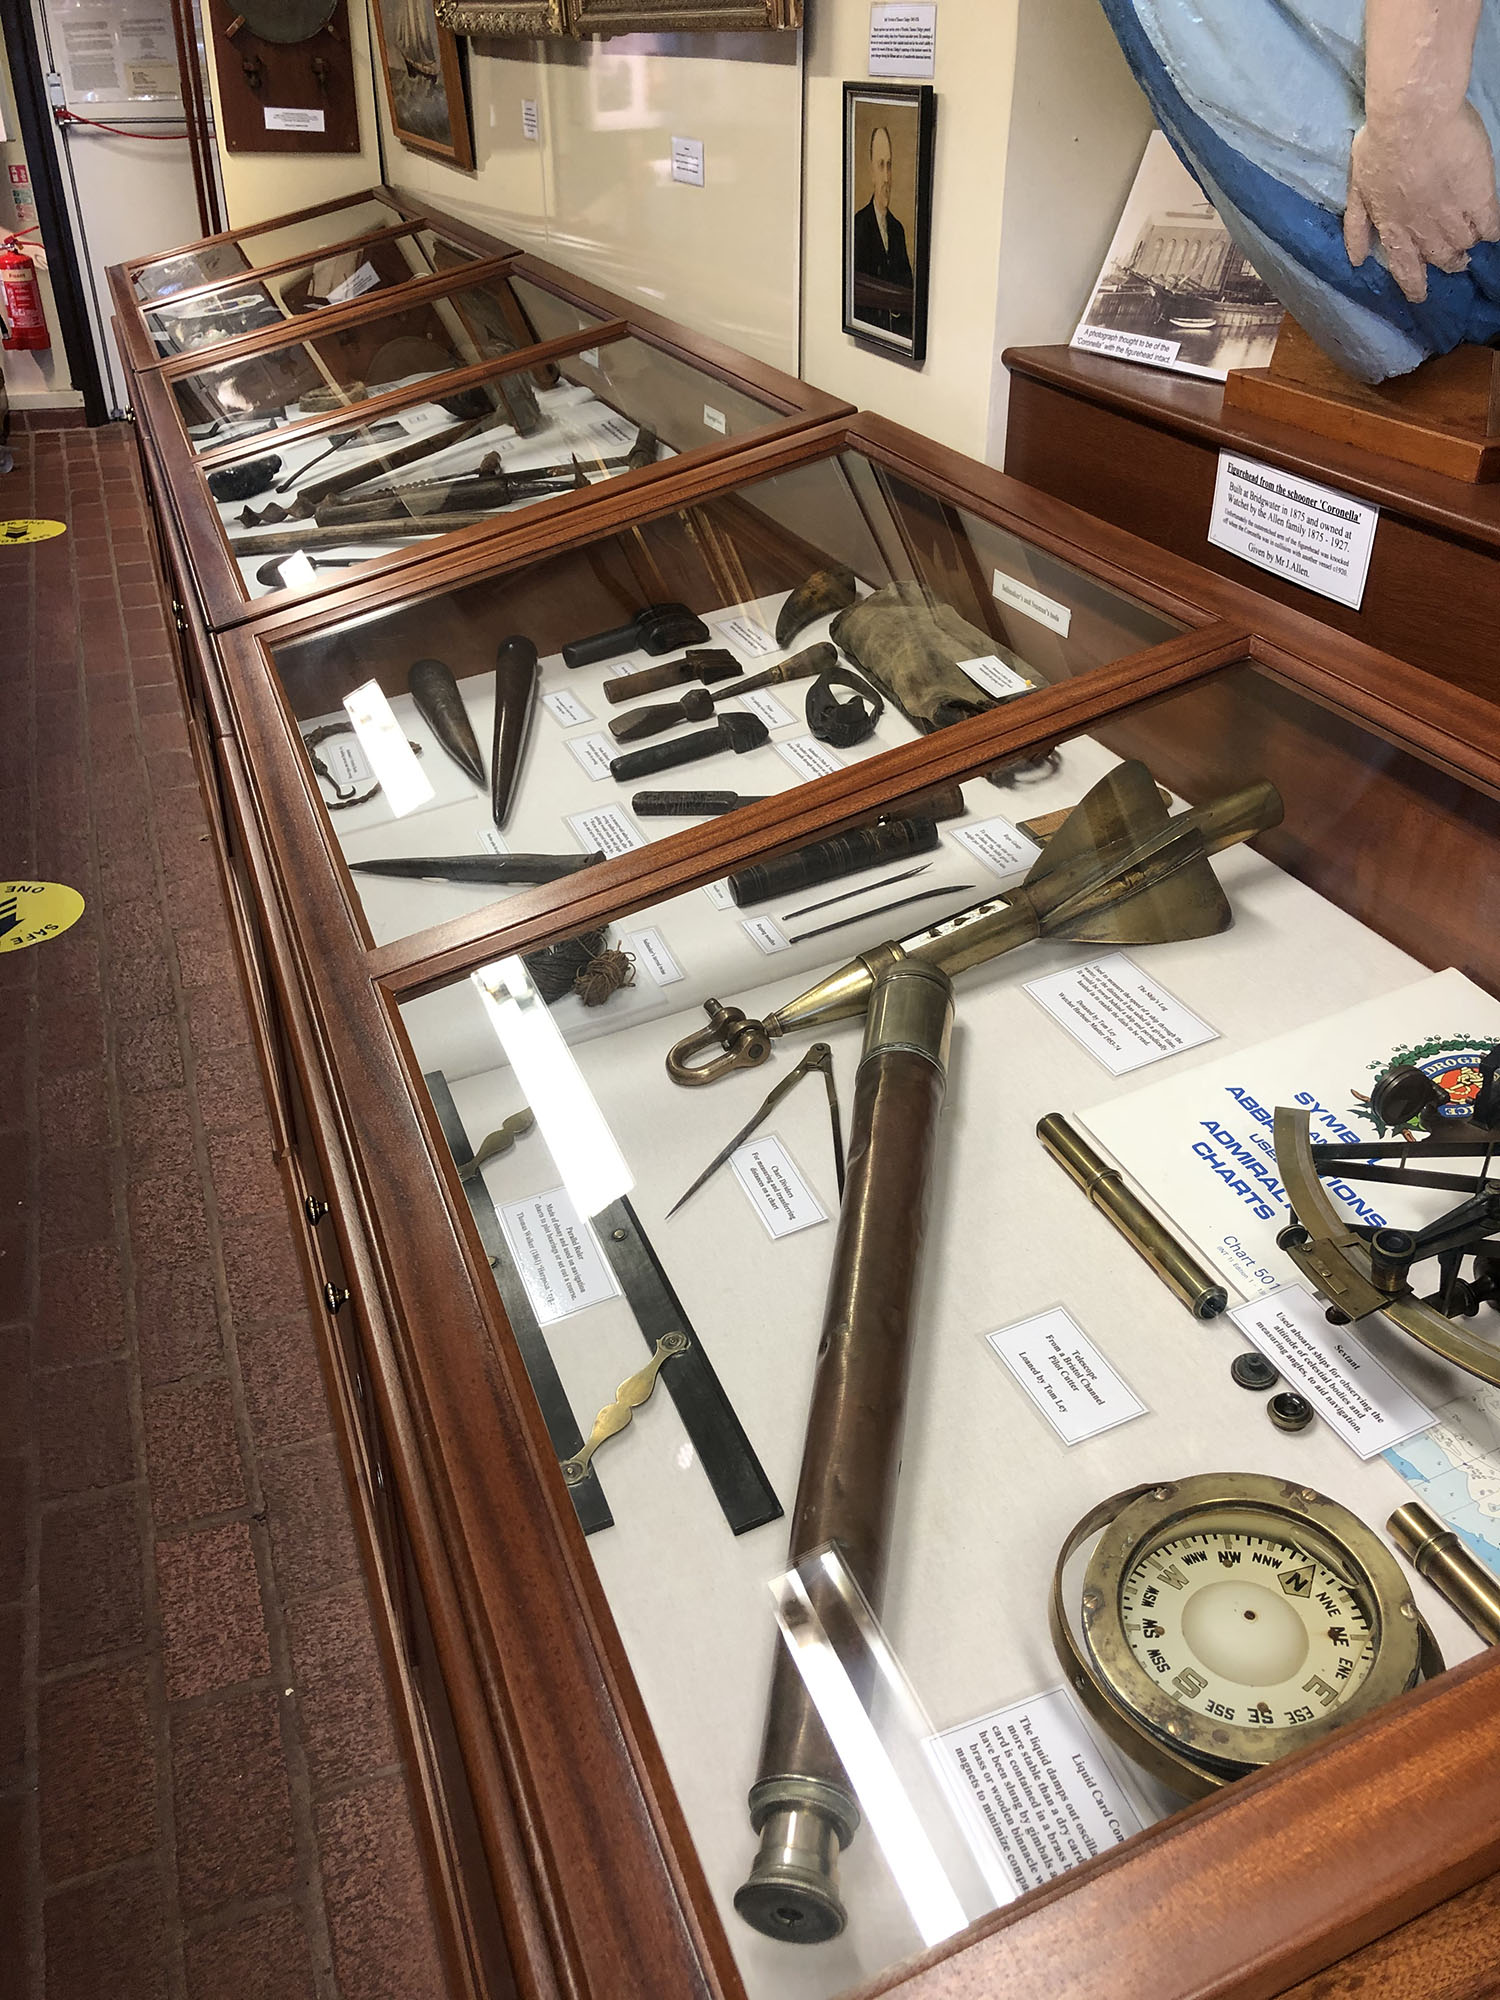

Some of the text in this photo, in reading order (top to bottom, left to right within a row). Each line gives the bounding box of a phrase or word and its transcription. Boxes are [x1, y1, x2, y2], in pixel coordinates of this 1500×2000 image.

[1227, 462, 1361, 524] Figurehead from the schooner 'Coronella'
[1228, 493, 1249, 511] Watchet
[1249, 503, 1257, 516] by
[1257, 507, 1266, 519] the
[1267, 511, 1284, 526] Allen
[1285, 519, 1306, 537] family
[1307, 528, 1324, 542] 1875
[1330, 536, 1349, 553] 1927.
[1229, 481, 1352, 541] Built at Bridgwater in 1875 and owned at
[1248, 542, 1284, 566] Given by Mr
[5, 885, 46, 894] ONE
[10, 923, 59, 946] SAFE
[1294, 1091, 1376, 1158] SYMB
[1200, 1121, 1292, 1208] ADMIRAL
[1249, 1133, 1278, 1164] USE
[771, 1165, 794, 1198] Chart Dividers
[1191, 1141, 1276, 1221] CHARTS
[1223, 1235, 1256, 1267] Chart
[1254, 1268, 1281, 1291] 501
[1045, 1334, 1062, 1352] From
[1062, 1356, 1084, 1378] Bristol
[1079, 1378, 1105, 1405] Channel
[1048, 1355, 1080, 1391] Pilot Cutter
[1071, 1349, 1098, 1380] Telescope
[1273, 1325, 1366, 1419] altitude of celestial bodies and
[1275, 1311, 1385, 1423] Used aboard ships for observing the
[1333, 1344, 1361, 1370] Sextant
[1018, 1351, 1068, 1413] Loaned by Tom Ley
[1255, 1321, 1289, 1355] measuring
[1285, 1354, 1308, 1377] angles,
[1307, 1376, 1317, 1384] to
[1314, 1384, 1329, 1396] aid
[1324, 1396, 1362, 1433] navigation.
[1182, 1551, 1207, 1566] WNW
[1218, 1551, 1241, 1564] NW
[1252, 1552, 1283, 1569] NNW
[1157, 1564, 1189, 1590] W
[1285, 1573, 1306, 1592] N
[1141, 1585, 1159, 1607] WSW
[1316, 1592, 1341, 1617] NNE
[1143, 1618, 1159, 1639] SW
[1331, 1627, 1348, 1647] NE
[1147, 1650, 1170, 1673] SSW
[1172, 1667, 1208, 1698] S
[1302, 1675, 1339, 1706] E
[1205, 1699, 1235, 1720] SSE
[1248, 1708, 1273, 1723] SE
[1284, 1706, 1314, 1725] ESE
[953, 1747, 980, 1788] magnets
[1018, 1715, 1034, 1735] The
[1028, 1736, 1051, 1766] liquid
[1045, 1767, 1069, 1802] damps
[1065, 1803, 1080, 1821] out
[976, 1790, 987, 1801] to
[977, 1730, 1054, 1869] have been slung by gimbals
[991, 1725, 1067, 1862] card is contained in a brass
[1006, 1724, 1087, 1864] more stable than a dry card
[1071, 1753, 1113, 1817] Liquid Card
[968, 1742, 1040, 1873] brass or wooden binnacle
[981, 1802, 1012, 1852] minimize
